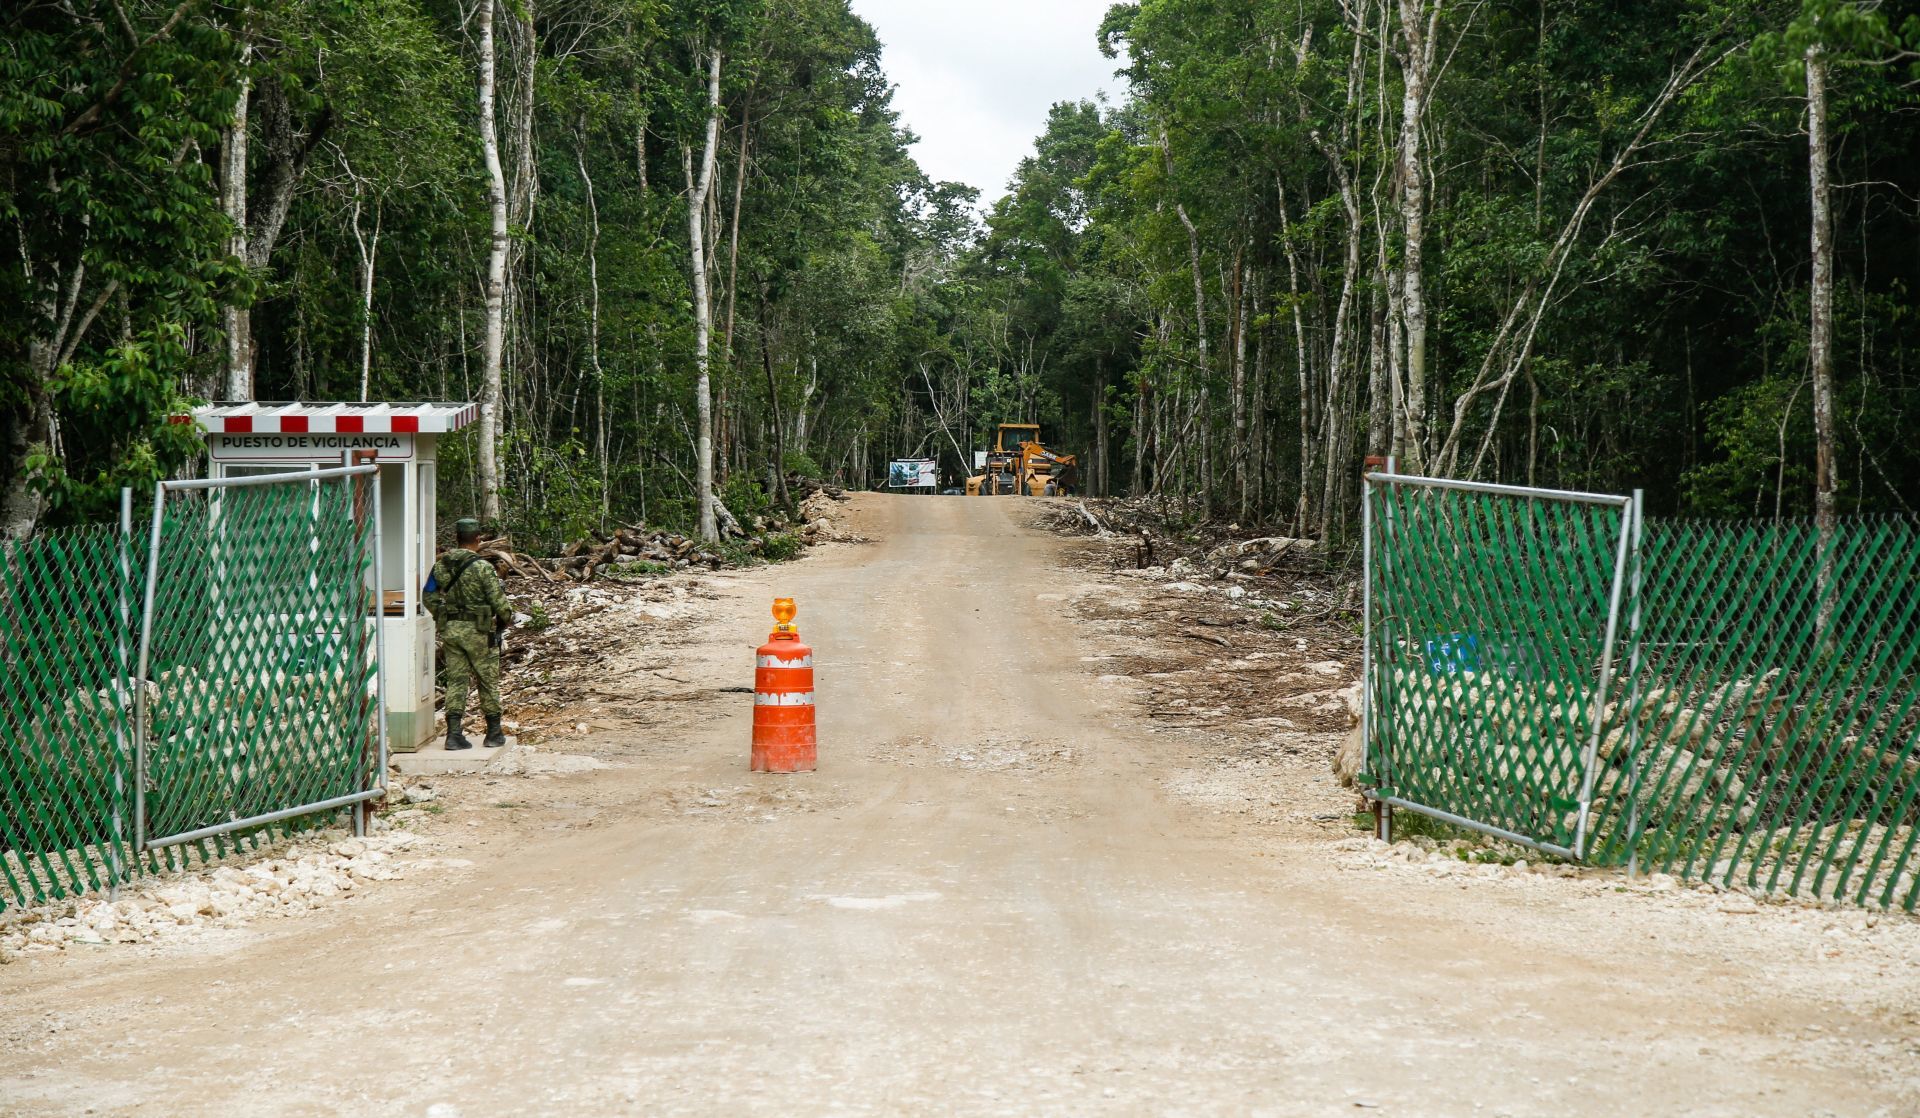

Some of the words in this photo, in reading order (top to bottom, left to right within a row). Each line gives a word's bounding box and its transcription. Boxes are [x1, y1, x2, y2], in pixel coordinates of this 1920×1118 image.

[222, 436, 282, 448] PUESTO
[288, 436, 307, 448] DE
[313, 436, 400, 448] VIGILANCIA
